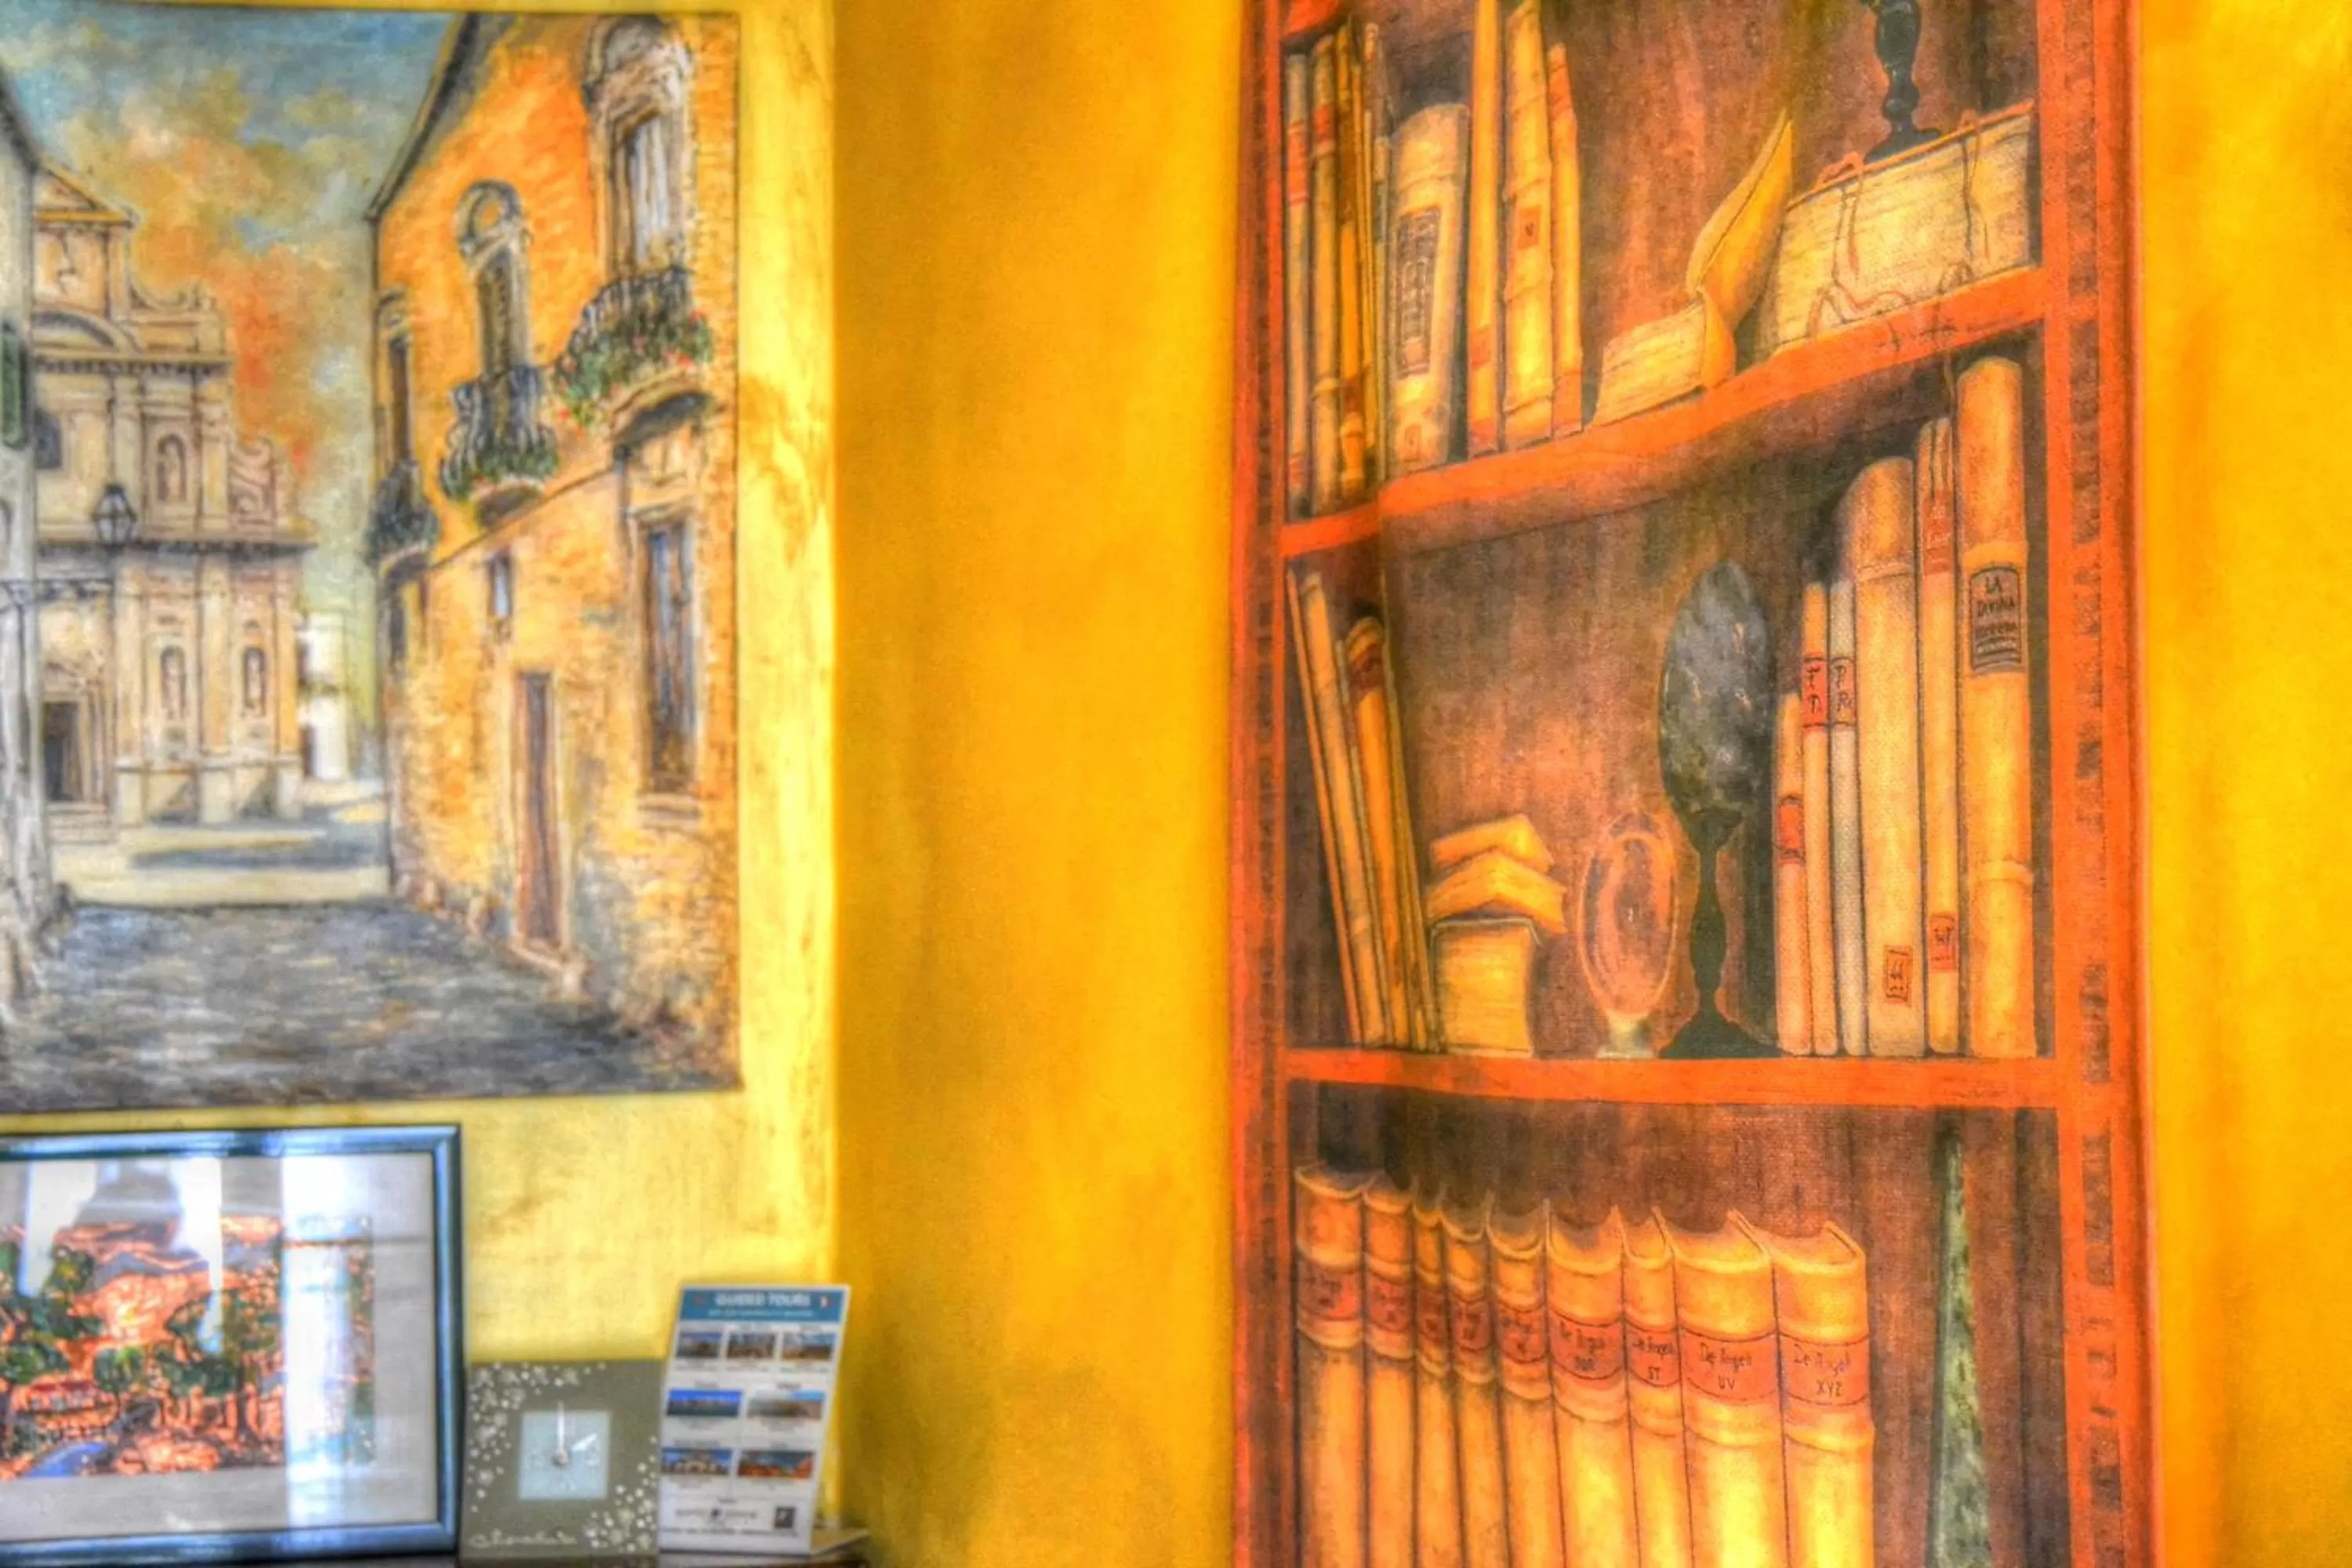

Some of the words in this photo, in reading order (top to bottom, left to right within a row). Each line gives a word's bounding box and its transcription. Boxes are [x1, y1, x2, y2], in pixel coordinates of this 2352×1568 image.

[1984, 575, 2003, 594] LA
[768, 1293, 811, 1308] TOURS
[1718, 1374, 1735, 1390] UV
[1816, 1379, 1842, 1397] XYZ
